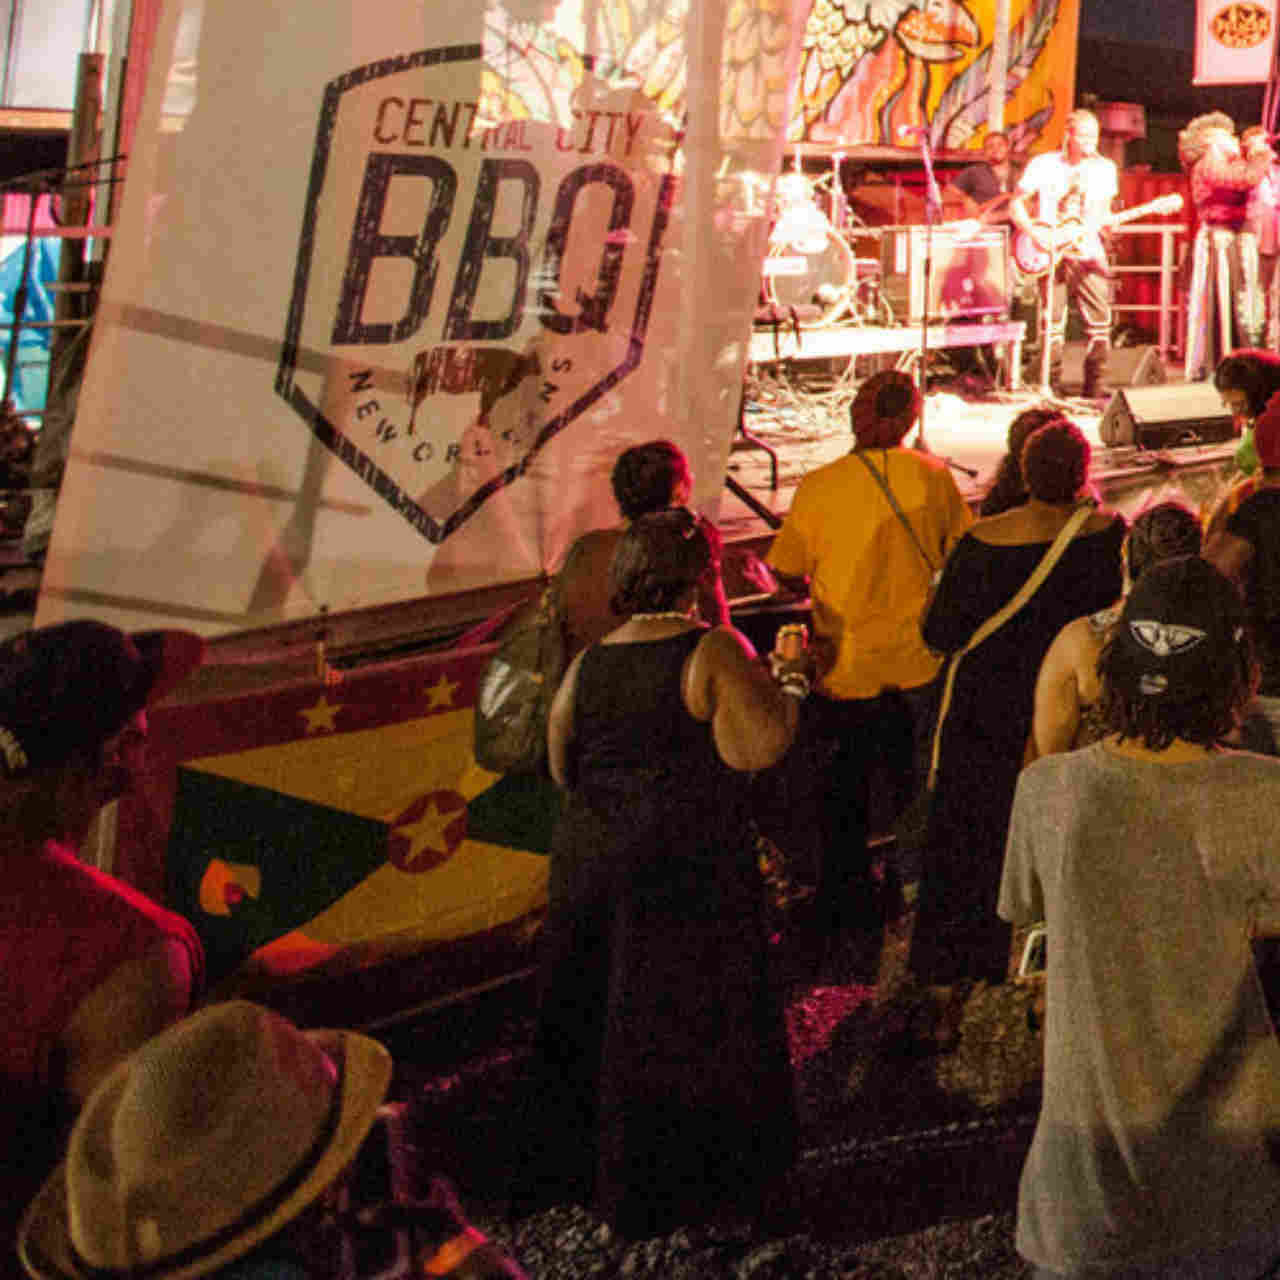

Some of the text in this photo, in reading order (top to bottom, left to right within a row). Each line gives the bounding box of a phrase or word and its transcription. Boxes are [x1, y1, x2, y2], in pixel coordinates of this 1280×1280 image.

[372, 96, 645, 156] CENTRAL CITY
[331, 152, 636, 346] BBQ
